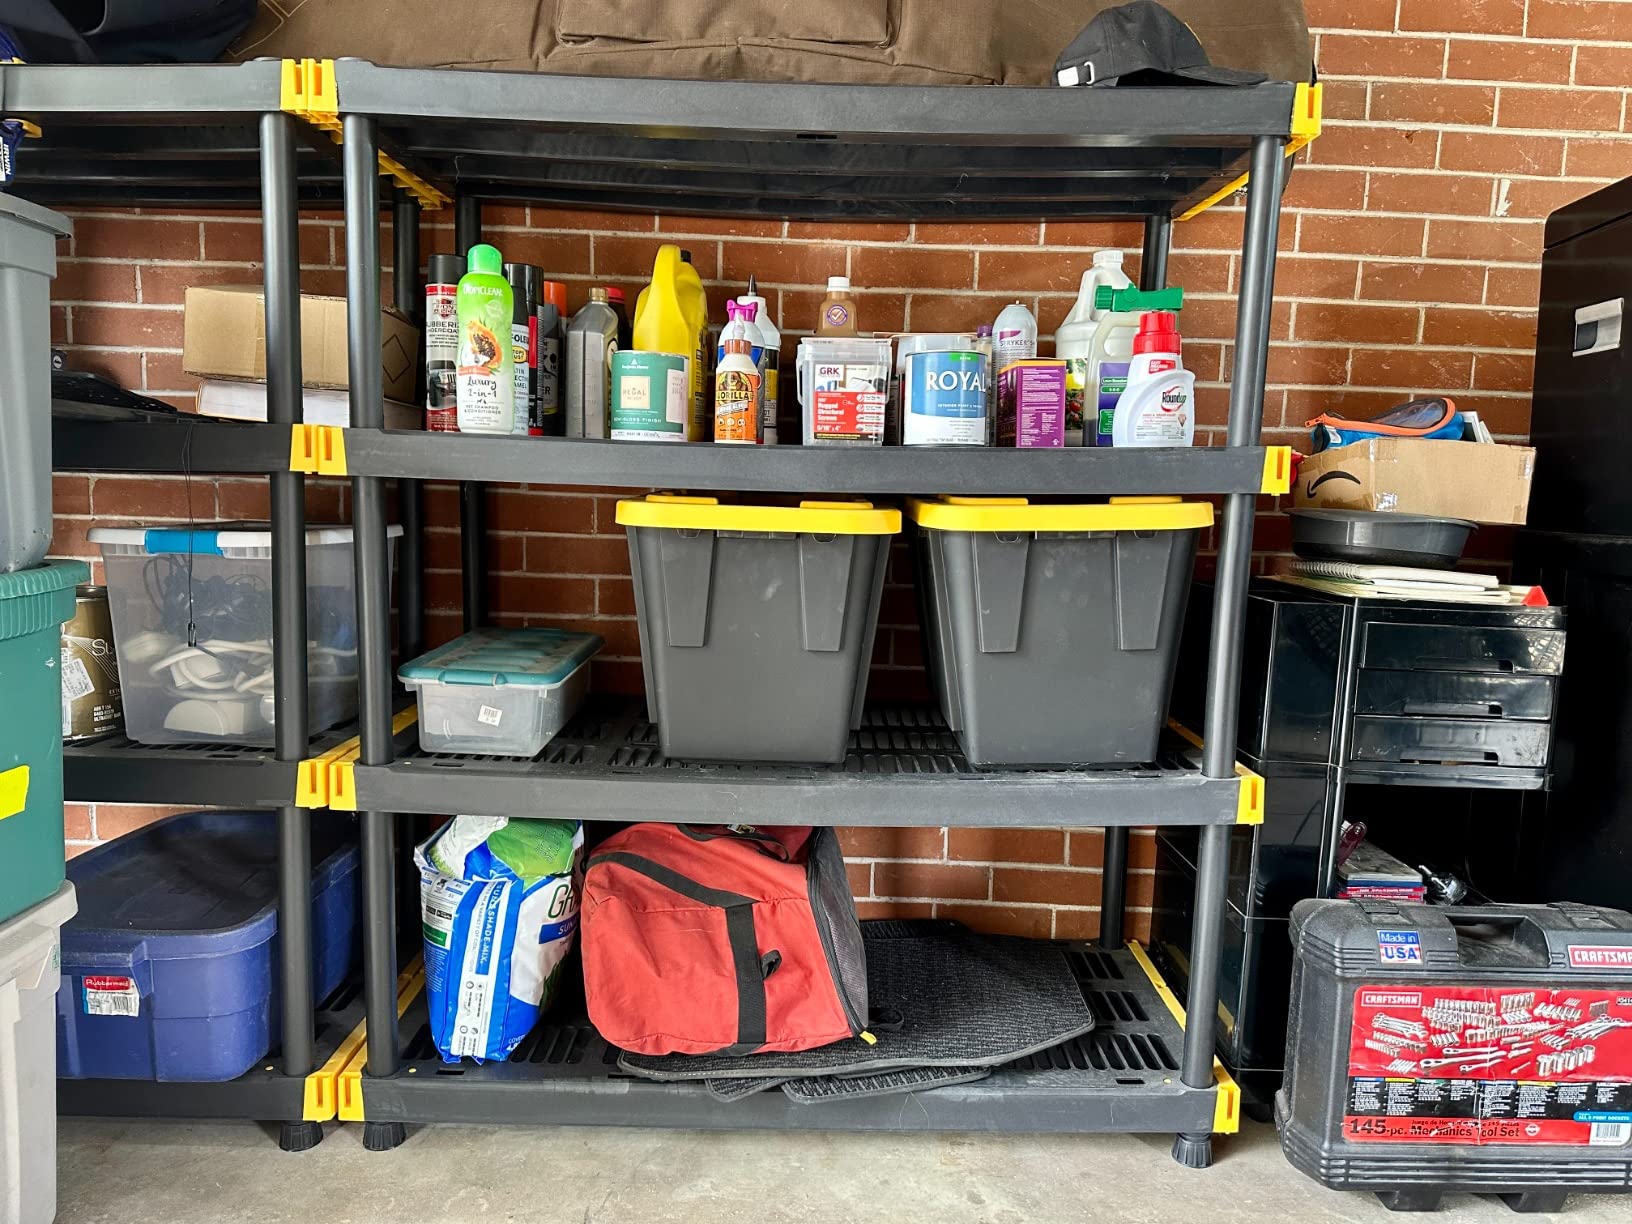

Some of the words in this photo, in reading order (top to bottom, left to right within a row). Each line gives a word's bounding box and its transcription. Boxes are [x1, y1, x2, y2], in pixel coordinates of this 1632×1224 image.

[3, 143, 12, 176] IRWIN
[820, 367, 839, 375] GRK
[467, 376, 497, 391] Luxury
[926, 370, 986, 392] ROYAL
[468, 388, 497, 398] 2-in-1
[1162, 391, 1187, 404] Roundup
[483, 909, 496, 943] SHADE
[1380, 933, 1405, 943] Made
[1407, 933, 1416, 943] in
[1384, 946, 1418, 960] USA
[85, 979, 129, 987] Rubbermaid
[1365, 995, 1419, 1006] CRAFTSMAN
[1410, 1125, 1472, 1137] Mechanics
[1499, 1127, 1520, 1137] Set
